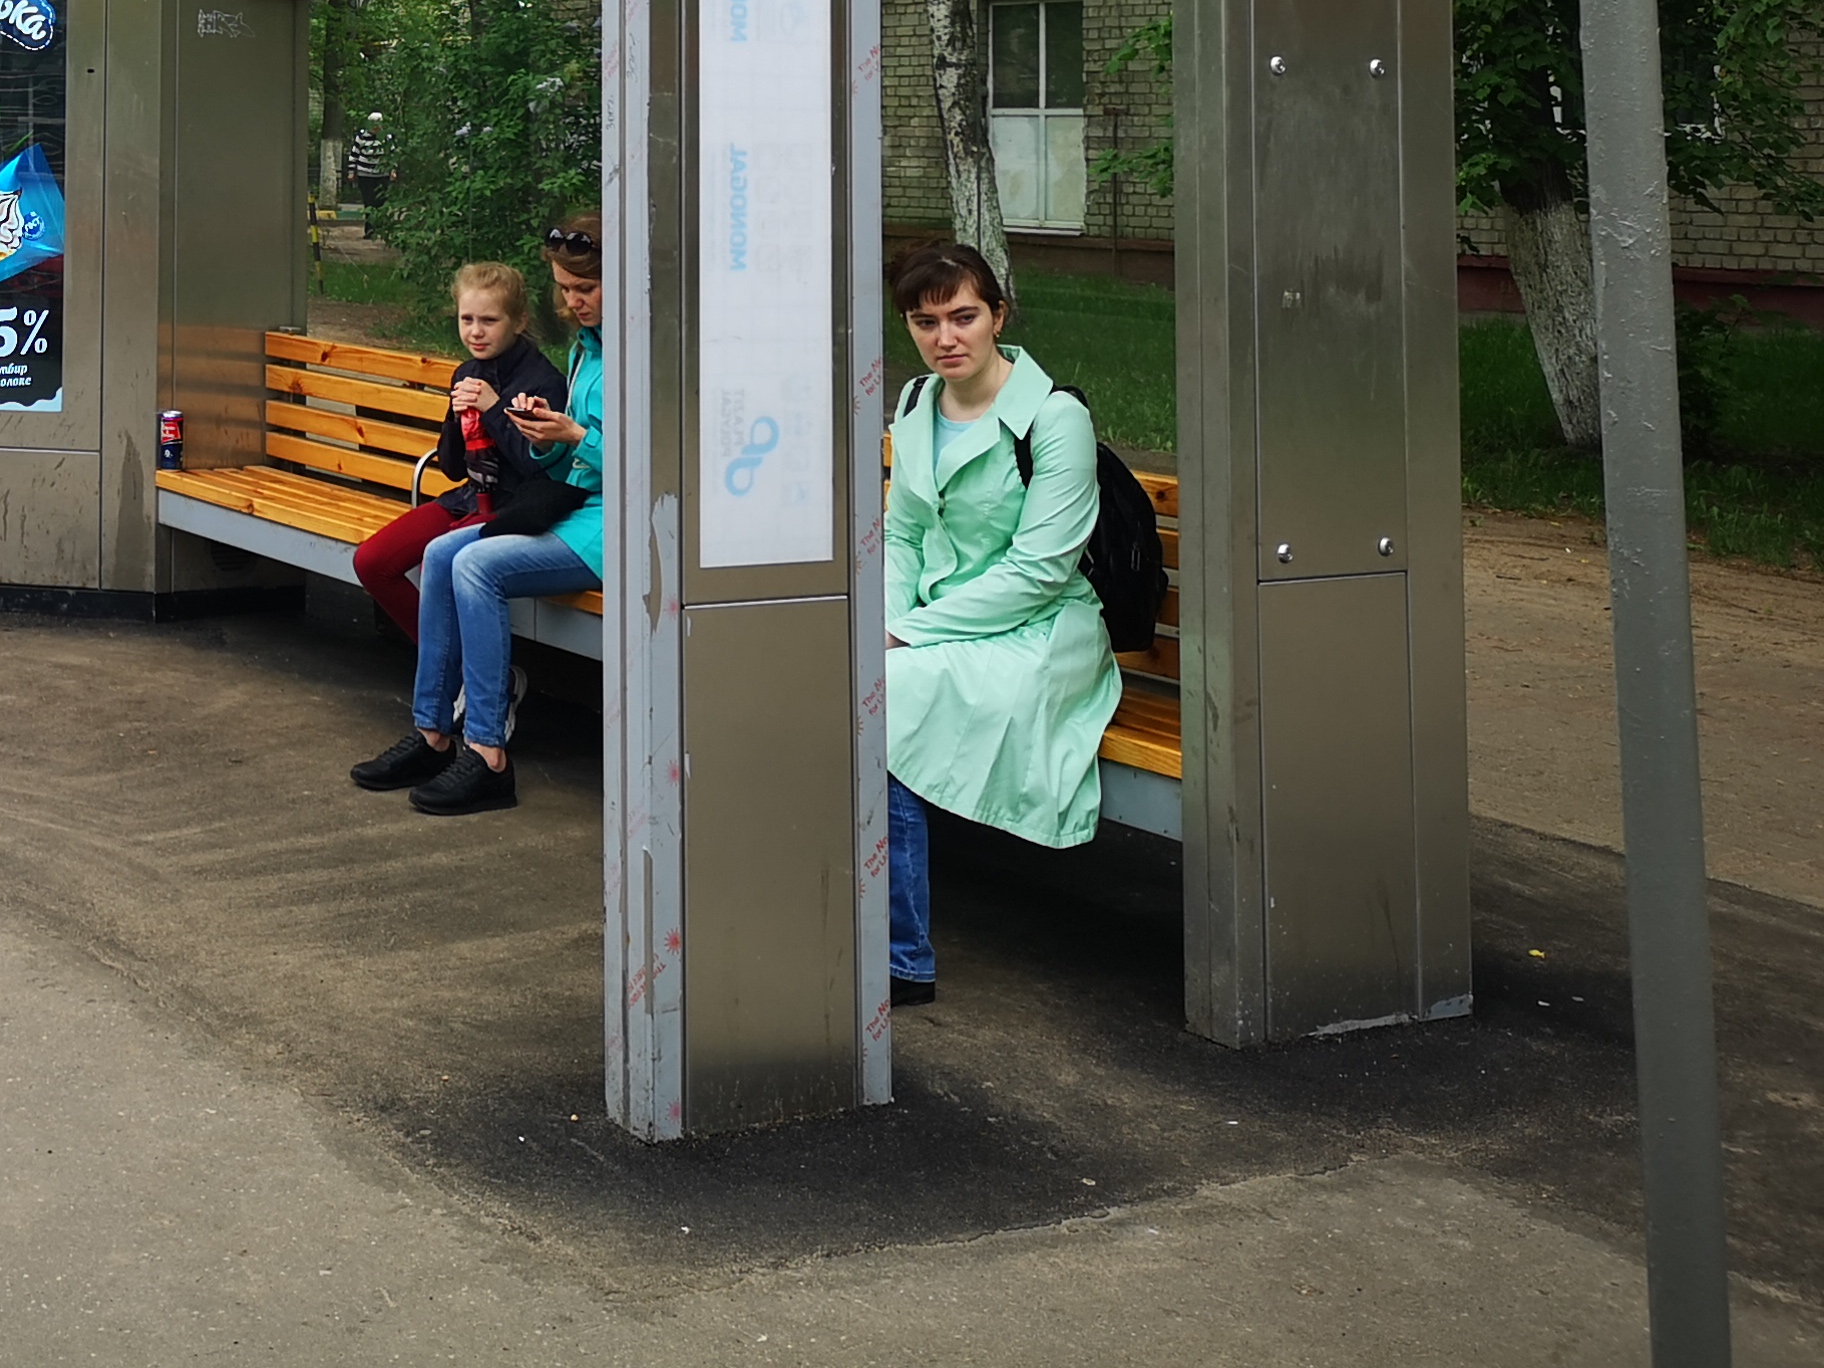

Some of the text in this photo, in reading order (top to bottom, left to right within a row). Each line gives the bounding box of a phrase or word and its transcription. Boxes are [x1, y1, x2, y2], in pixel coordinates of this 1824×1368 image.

[859, 372, 873, 387] The
[864, 853, 878, 869] The
[866, 1016, 879, 1032] The
